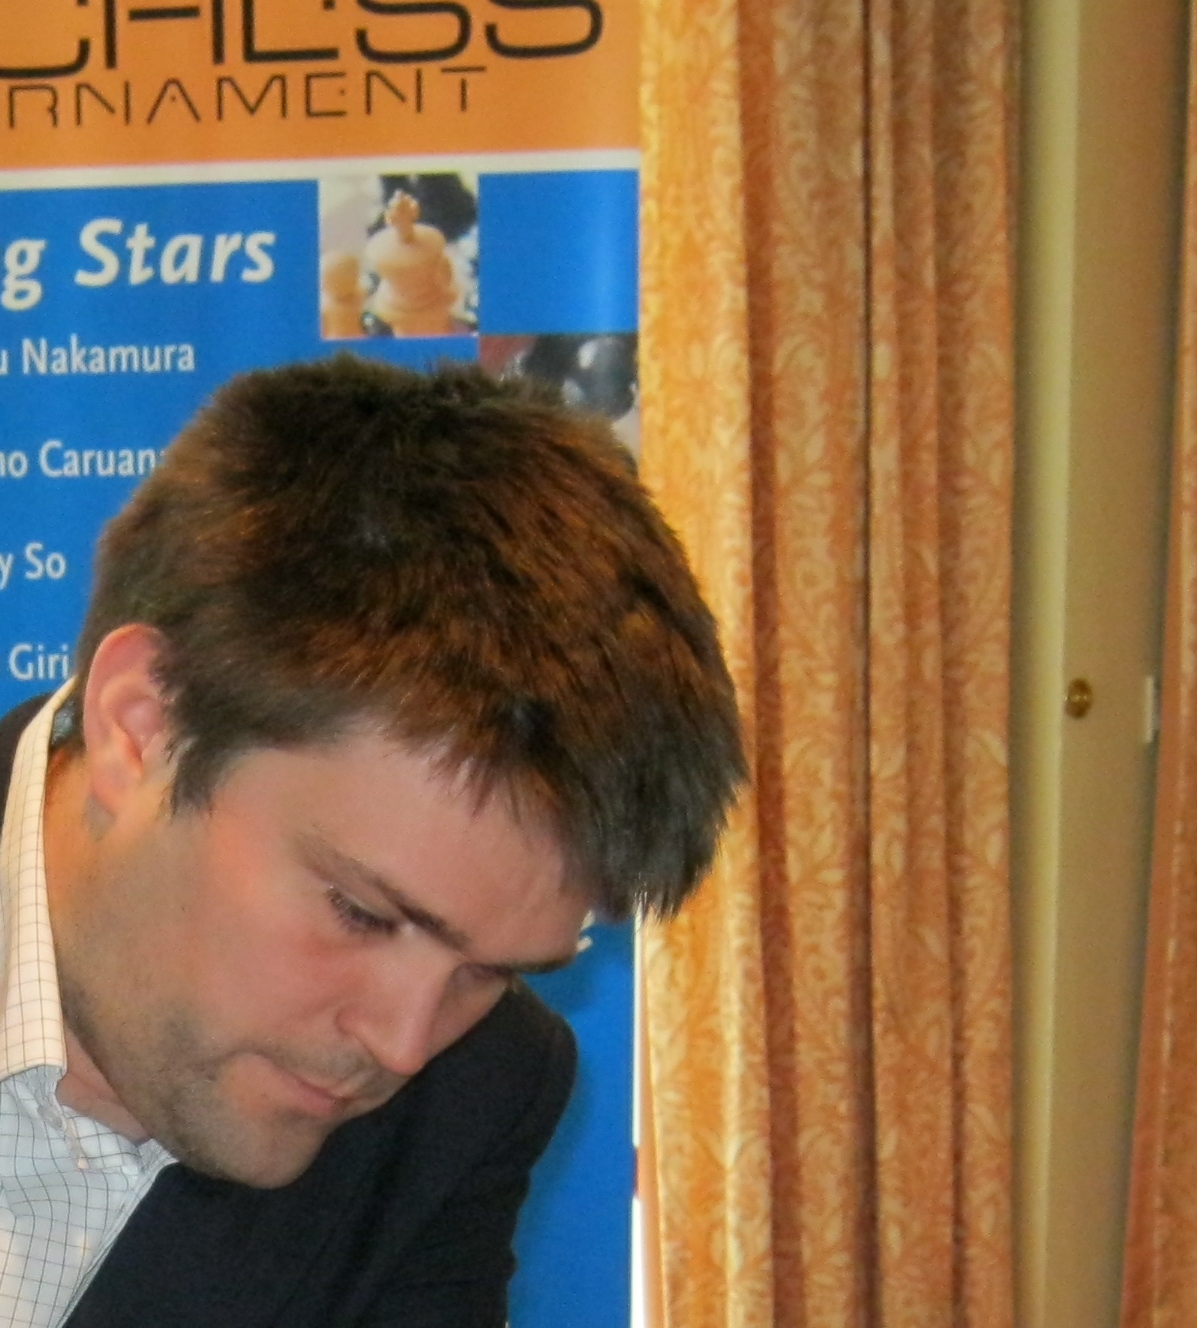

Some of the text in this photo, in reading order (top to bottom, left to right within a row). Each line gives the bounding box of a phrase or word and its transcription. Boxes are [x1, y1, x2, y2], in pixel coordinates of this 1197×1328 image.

[74, 218, 276, 287] Stars
[22, 334, 195, 375] Nakamura
[39, 439, 166, 478] Caruan
[24, 542, 67, 580] So
[8, 643, 70, 681] Giri
